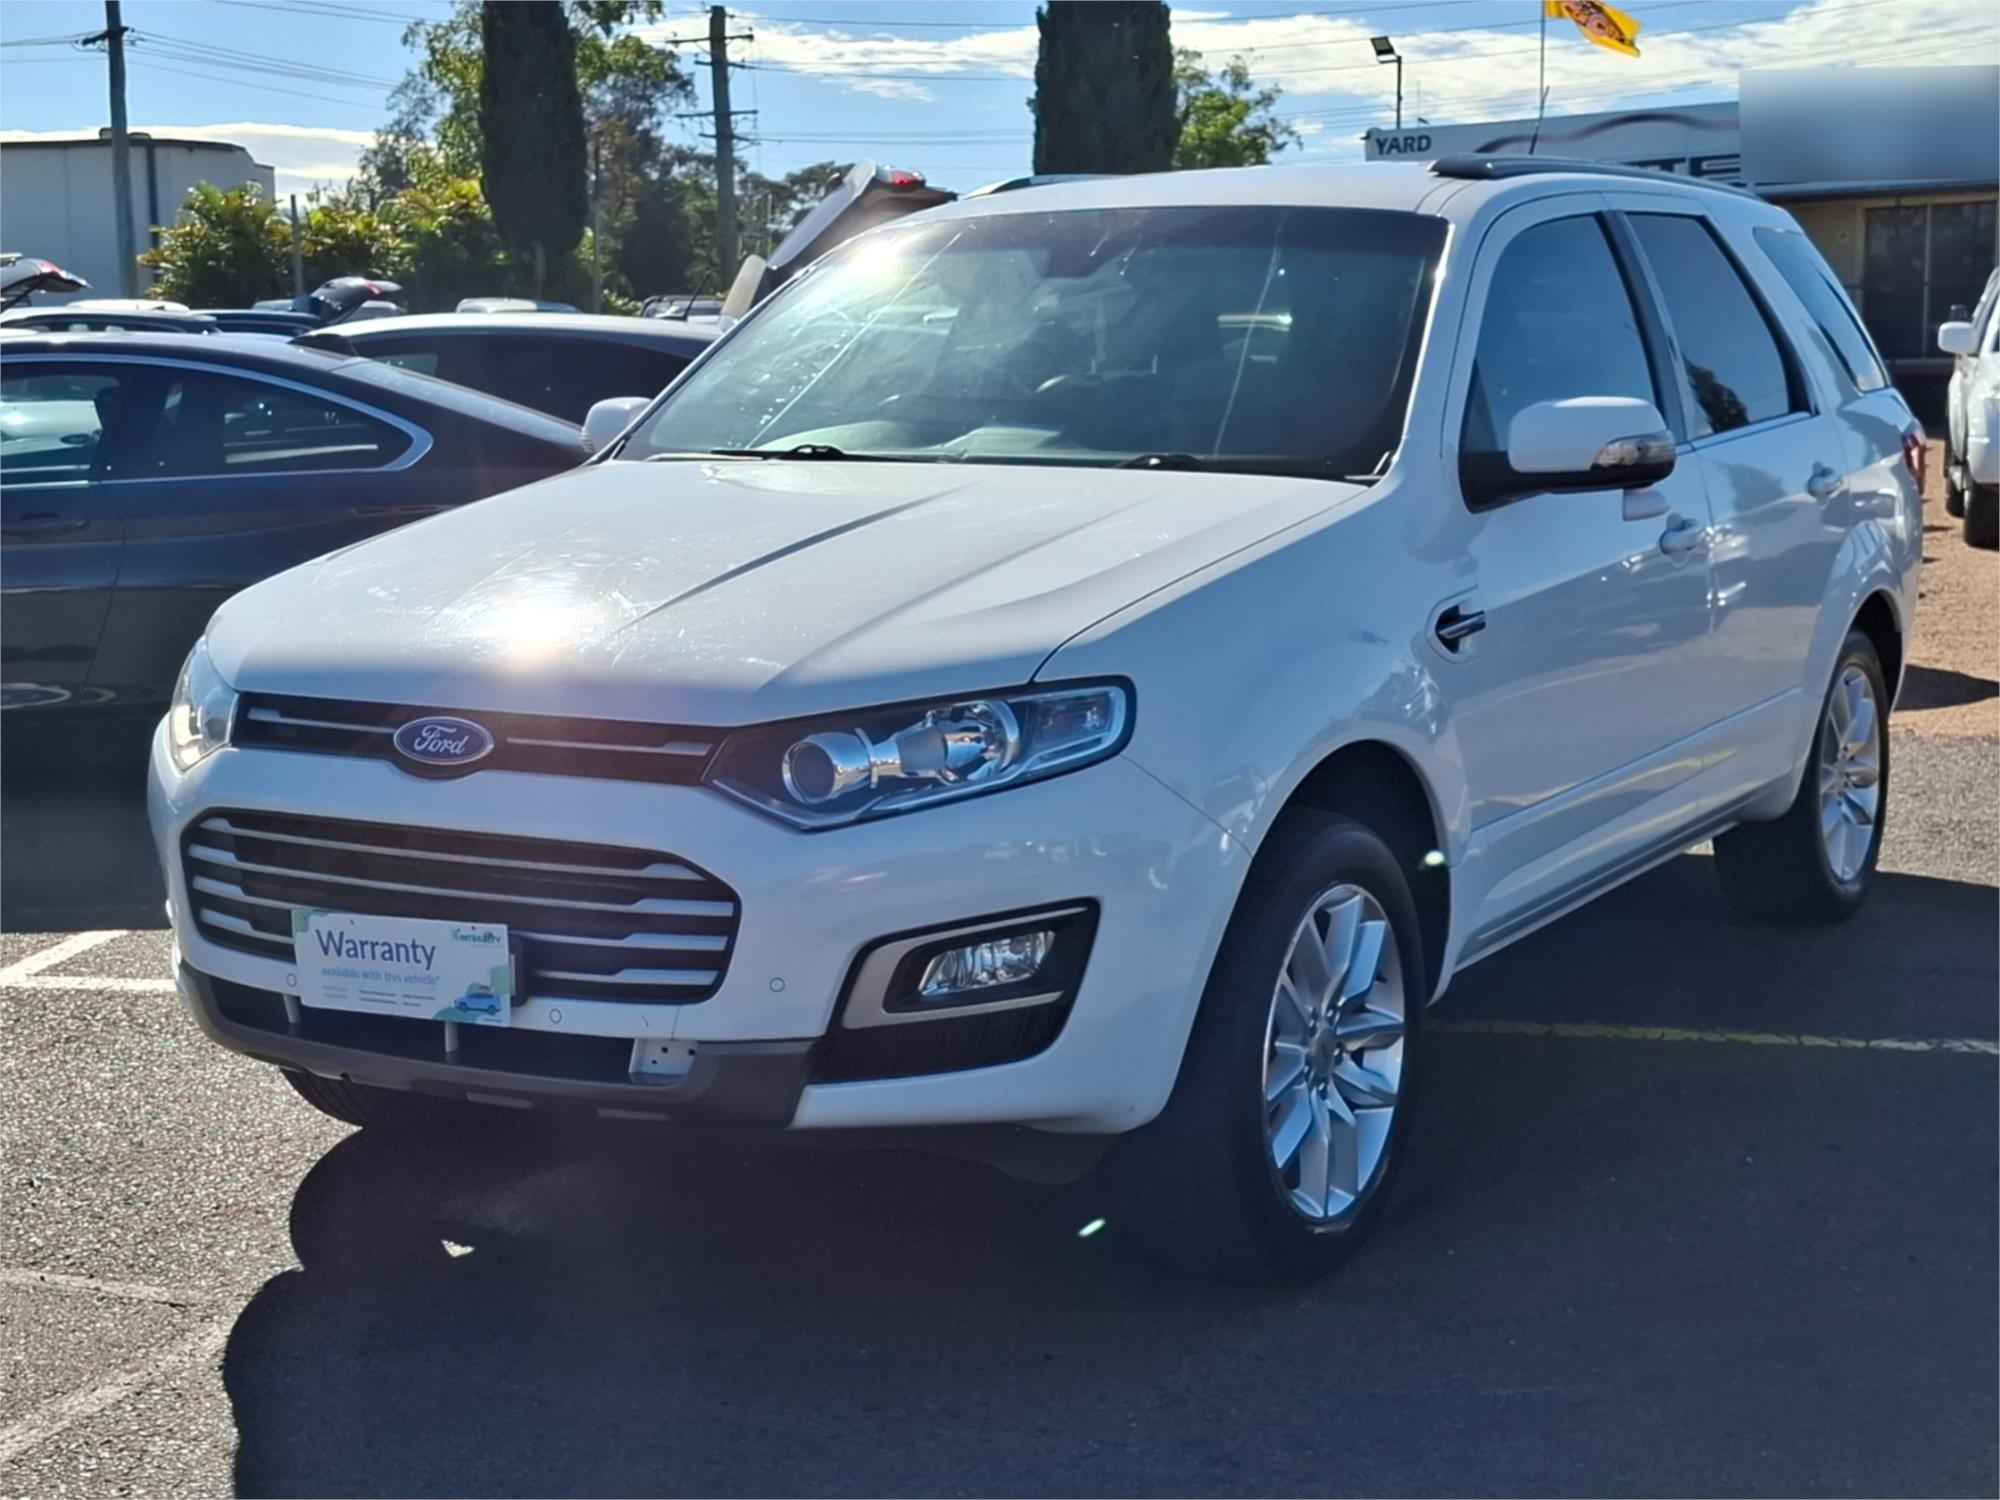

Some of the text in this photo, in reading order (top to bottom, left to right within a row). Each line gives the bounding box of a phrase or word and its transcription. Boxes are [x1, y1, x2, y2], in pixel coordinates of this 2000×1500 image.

[1375, 135, 1432, 156] YARD
[413, 724, 469, 754] Ford
[316, 928, 436, 971] Warranty
[361, 968, 382, 981] with
[384, 969, 402, 983] this
